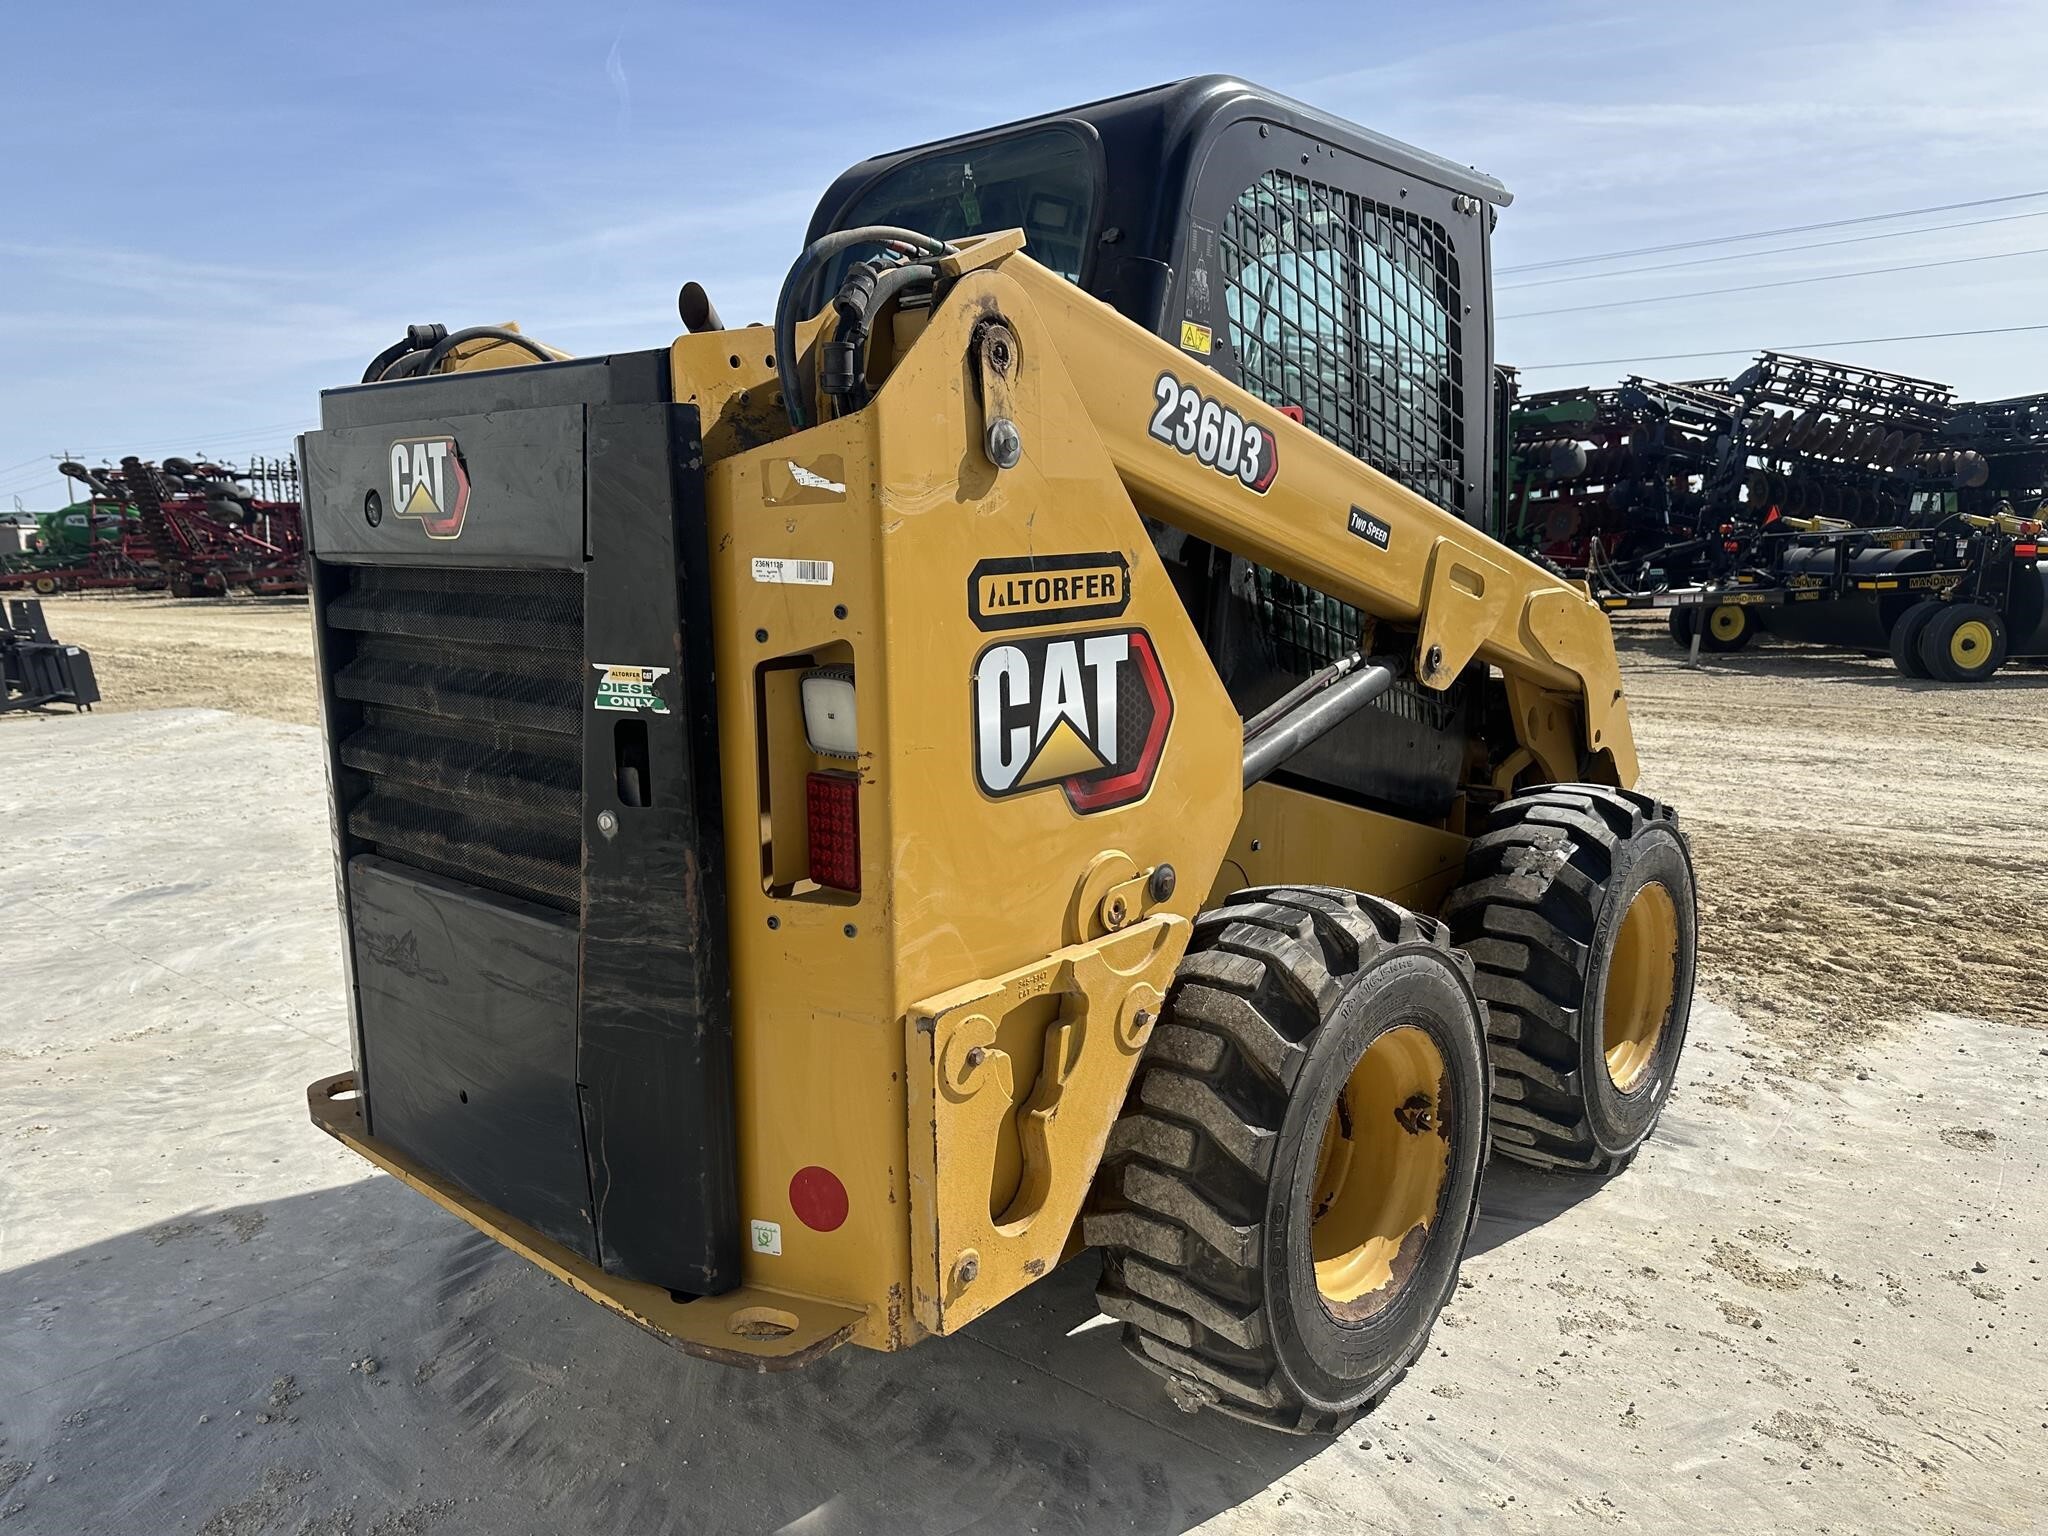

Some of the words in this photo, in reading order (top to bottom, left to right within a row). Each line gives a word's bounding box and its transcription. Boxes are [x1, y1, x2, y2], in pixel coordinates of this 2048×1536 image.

[1151, 376, 1263, 483] 236D3
[391, 442, 447, 513] CAT
[988, 573, 1116, 608] ALTORFER
[599, 682, 653, 695] DIESE
[611, 671, 641, 679] ALTORFER
[610, 696, 656, 708] ONLY
[978, 633, 1129, 791] CAT
